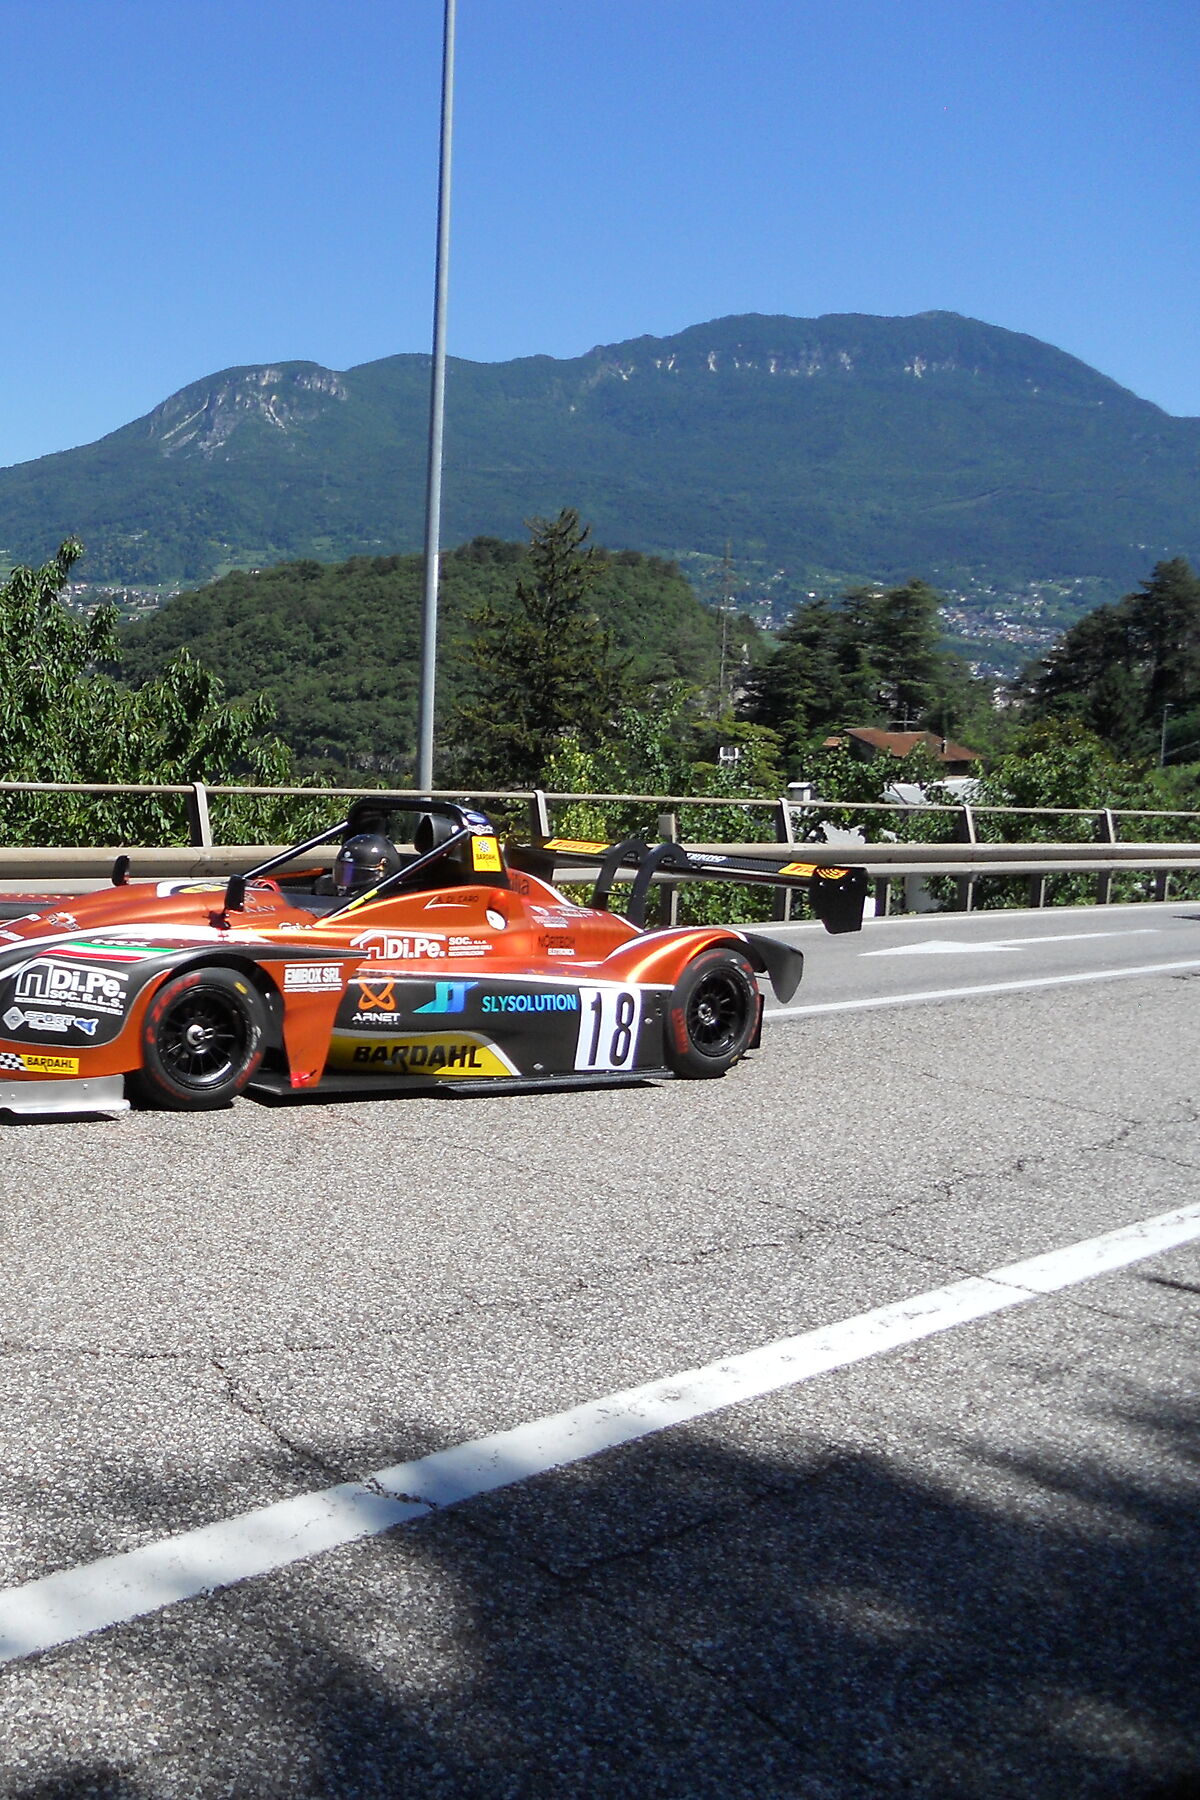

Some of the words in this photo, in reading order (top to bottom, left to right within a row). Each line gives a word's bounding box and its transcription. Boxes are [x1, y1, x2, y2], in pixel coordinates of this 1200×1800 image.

[388, 938, 446, 959] Di.Pe.
[322, 967, 342, 982] SRL
[50, 969, 127, 999] Di.Pe.
[49, 989, 81, 1002] SOC.
[481, 994, 577, 1013] SLYSOLUTION
[25, 1011, 76, 1027] SPORT
[351, 1012, 401, 1022] ARNET
[588, 991, 635, 1067] 18
[26, 1056, 75, 1071] BARDAHL
[353, 1046, 482, 1072] BARDAHL
